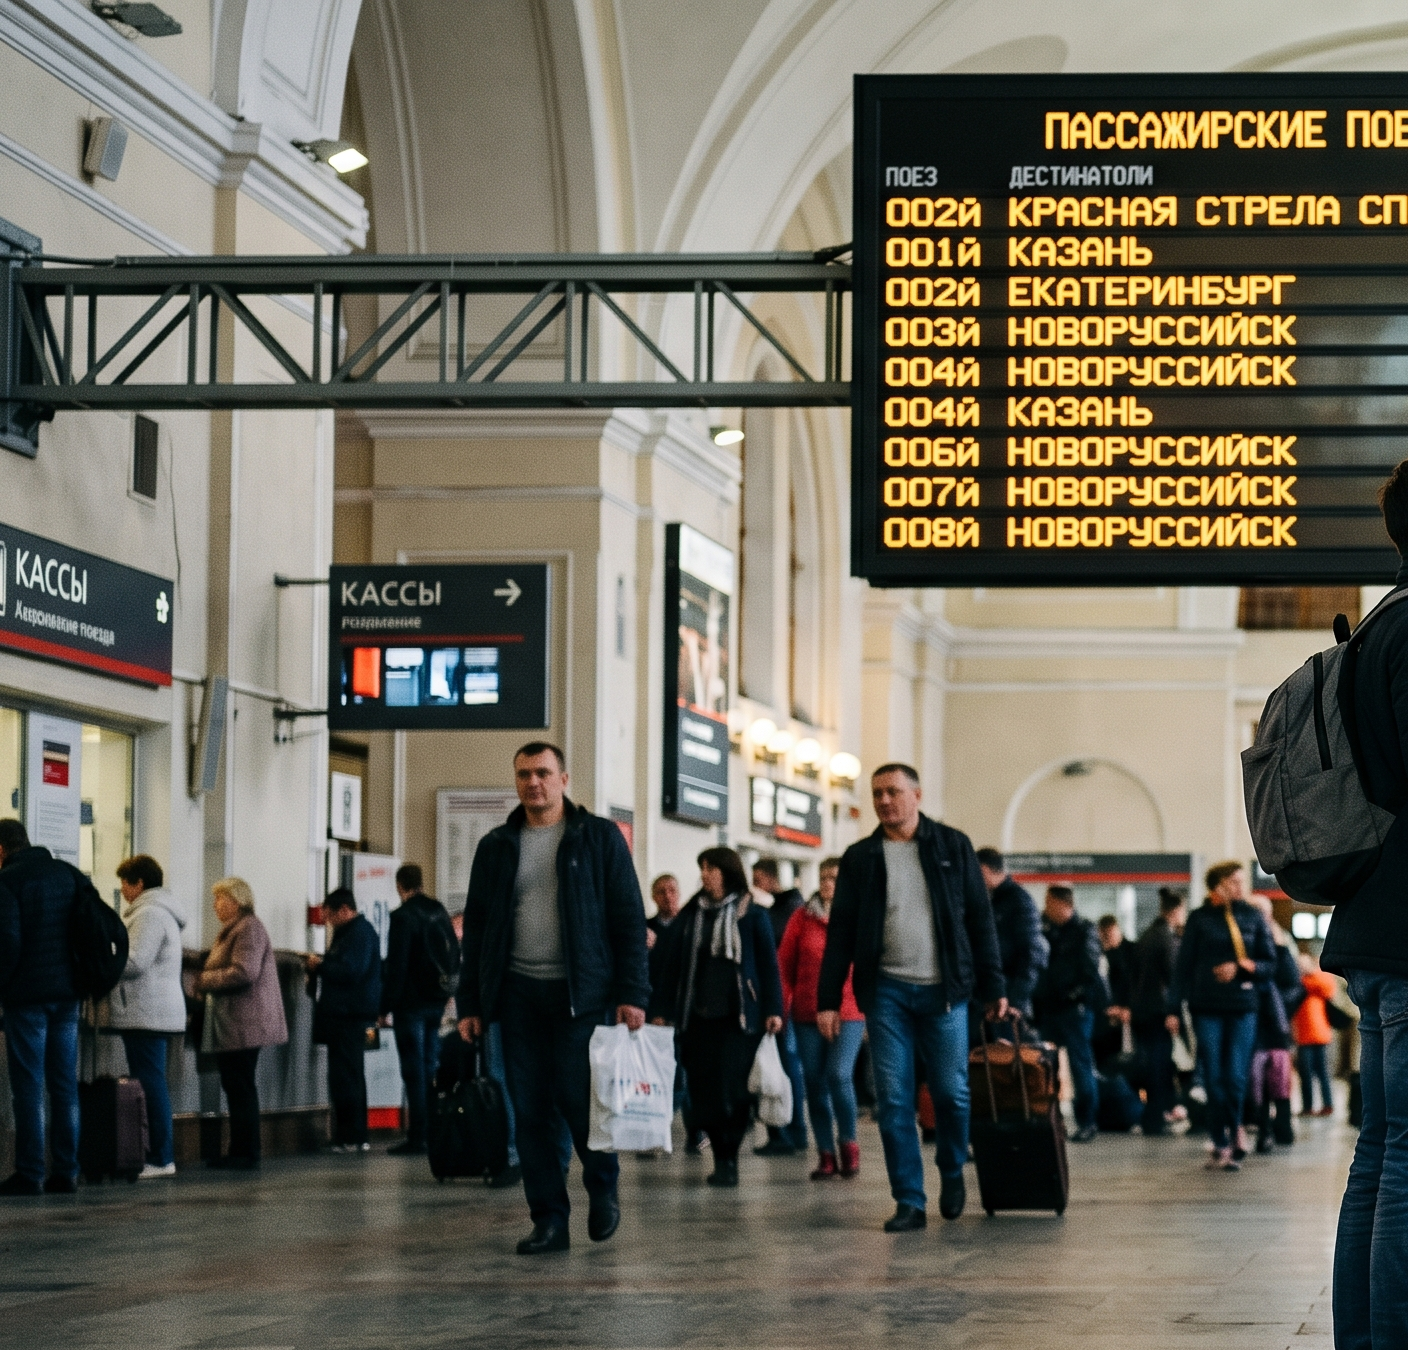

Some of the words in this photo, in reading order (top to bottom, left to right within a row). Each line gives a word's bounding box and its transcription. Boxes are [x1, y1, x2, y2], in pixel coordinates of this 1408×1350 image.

[1045, 110, 1326, 150] ПАССАЖИРСКИЕ
[885, 166, 938, 187] ПОЕЗ
[1009, 165, 1154, 189] ДЕСТИНАТОЛИ
[1009, 196, 1177, 226] КРАСНАЯ
[1196, 196, 1340, 225] СТРЕЛА
[1009, 236, 1152, 266] КАЗАНЬ
[1009, 275, 1296, 306] ЕКАТЕРИНБУРГ
[1008, 313, 1296, 346] НОВОРУССИЙСК
[1008, 353, 1296, 386] НОВОРУССИЙСК
[1008, 396, 1153, 426] КАЗАНЬ
[1008, 434, 1297, 466] НОВОРУССИЙСК
[1007, 474, 1297, 506] НОВОРУССИЙСК
[1007, 514, 1297, 547] НОВОРУССИЙСК
[16, 547, 88, 605] КАССЫ
[341, 580, 442, 607] КАССЫ
